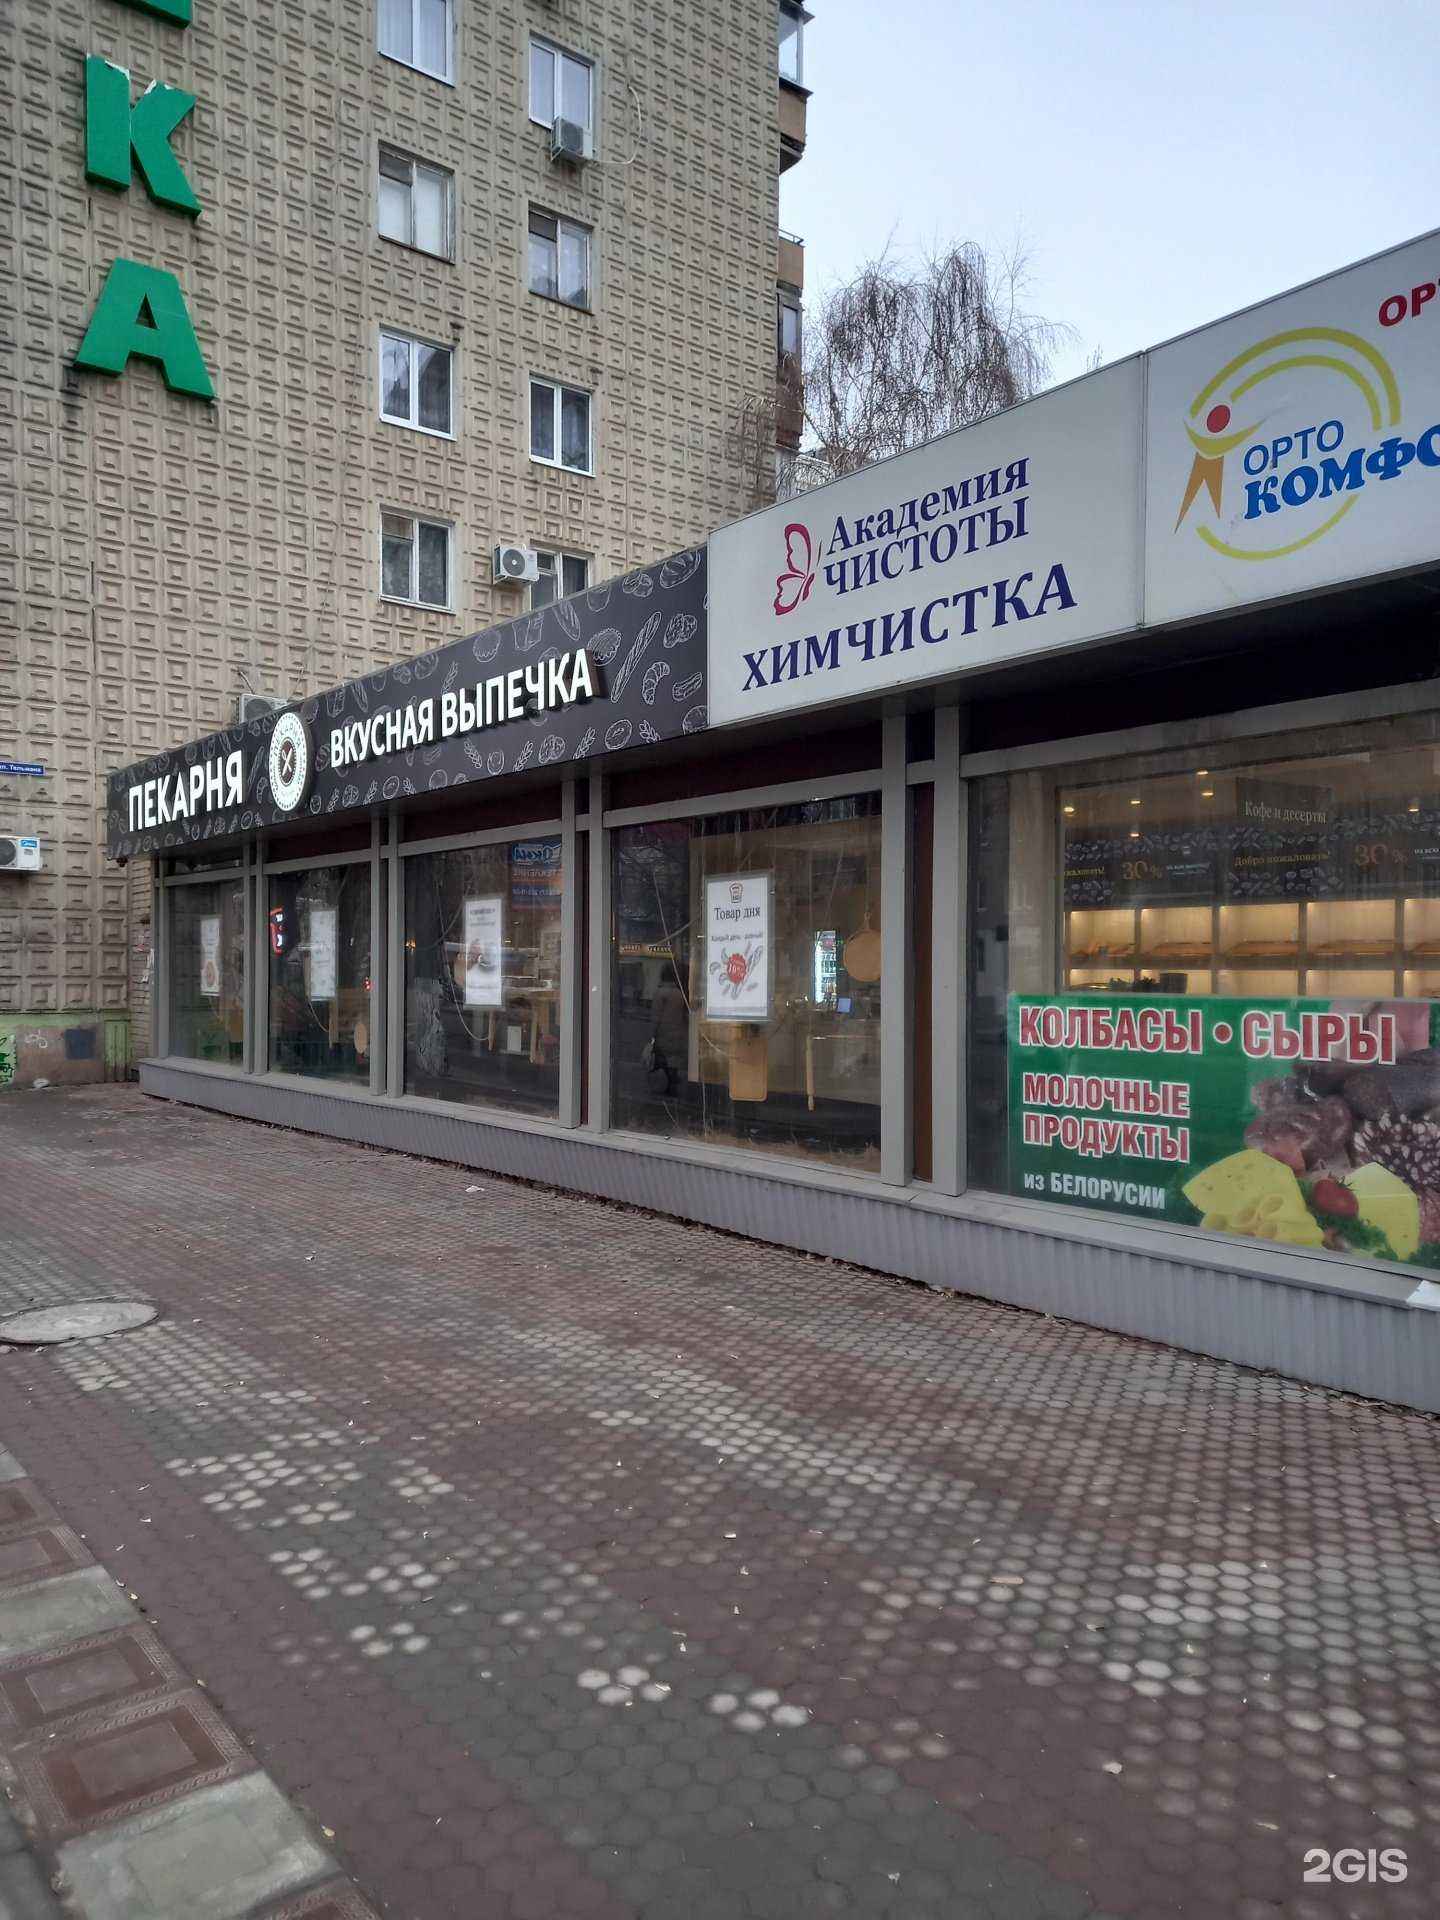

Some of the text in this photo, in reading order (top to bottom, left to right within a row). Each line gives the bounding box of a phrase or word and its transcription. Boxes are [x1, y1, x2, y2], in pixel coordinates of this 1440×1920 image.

[1378, 279, 1440, 327] ОР
[1243, 419, 1344, 476] ОРТО
[826, 457, 1029, 555] Академия
[823, 496, 1029, 596] ЧИСТОТЫ
[742, 563, 1078, 691] ХИМЧИСТКА
[330, 649, 593, 768] ВКУСНАЯ ВЫПЕЧКА
[129, 750, 243, 832] ПЕКАРНЯ
[1245, 801, 1272, 822] Кофе
[1283, 807, 1327, 825] десерты
[714, 906, 760, 921] Товар дня
[1019, 1006, 1396, 1065] КОЛБАСЫ СЫРЫ
[1023, 1072, 1190, 1118] МОЛОЧНЫЕ
[1023, 1112, 1190, 1163] ПРОДУКТЫ
[1051, 1172, 1166, 1210] БЕЛОРУСИИ
